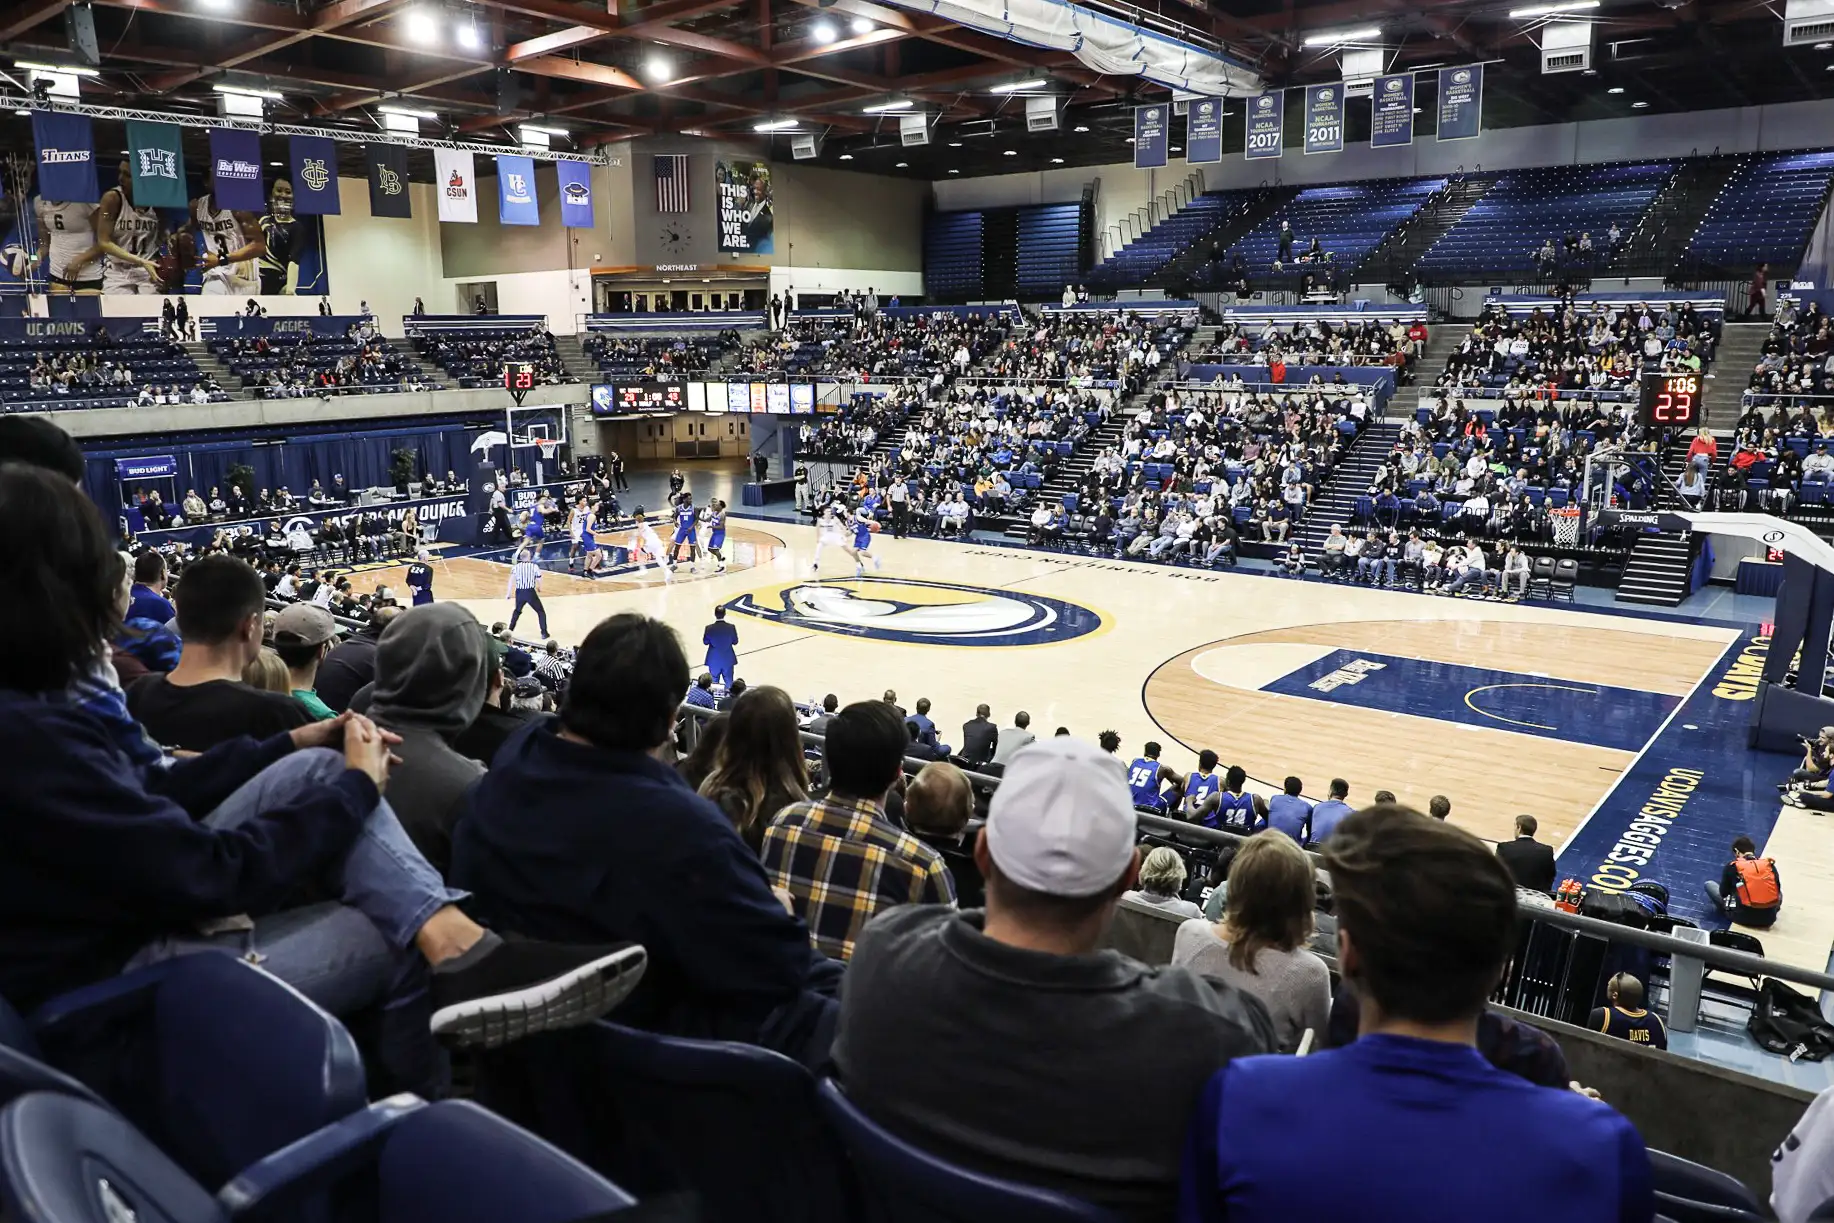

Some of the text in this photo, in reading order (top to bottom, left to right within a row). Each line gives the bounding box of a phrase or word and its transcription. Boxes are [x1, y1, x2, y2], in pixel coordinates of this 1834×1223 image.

[1309, 120, 1340, 128] TOURNAMENT
[1248, 132, 1280, 148] 2017
[1309, 126, 1340, 142] 2011
[446, 187, 468, 198] CSUN
[720, 183, 748, 197] THIS
[722, 196, 734, 209] IS
[54, 214, 65, 230] 6
[721, 209, 751, 223] WHO
[722, 222, 741, 234] WE
[214, 233, 229, 253] 3
[723, 235, 750, 248] ARE.
[26, 322, 86, 336] UC DAVIS
[273, 320, 311, 333] AGGIES
[516, 373, 531, 388] 23
[1667, 378, 1697, 394] 1:06
[1655, 394, 1691, 420] 23
[129, 465, 168, 475] BUD LIGHT
[518, 491, 537, 501] BUD
[514, 499, 537, 509] LIGH
[1619, 513, 1659, 525] SPALDING
[410, 566, 424, 574] 224
[961, 549, 1220, 583] BOB HAMILTON COURT
[1128, 767, 1153, 788] 35
[1195, 785, 1210, 805] 2
[1629, 1029, 1650, 1042] DAVIS
